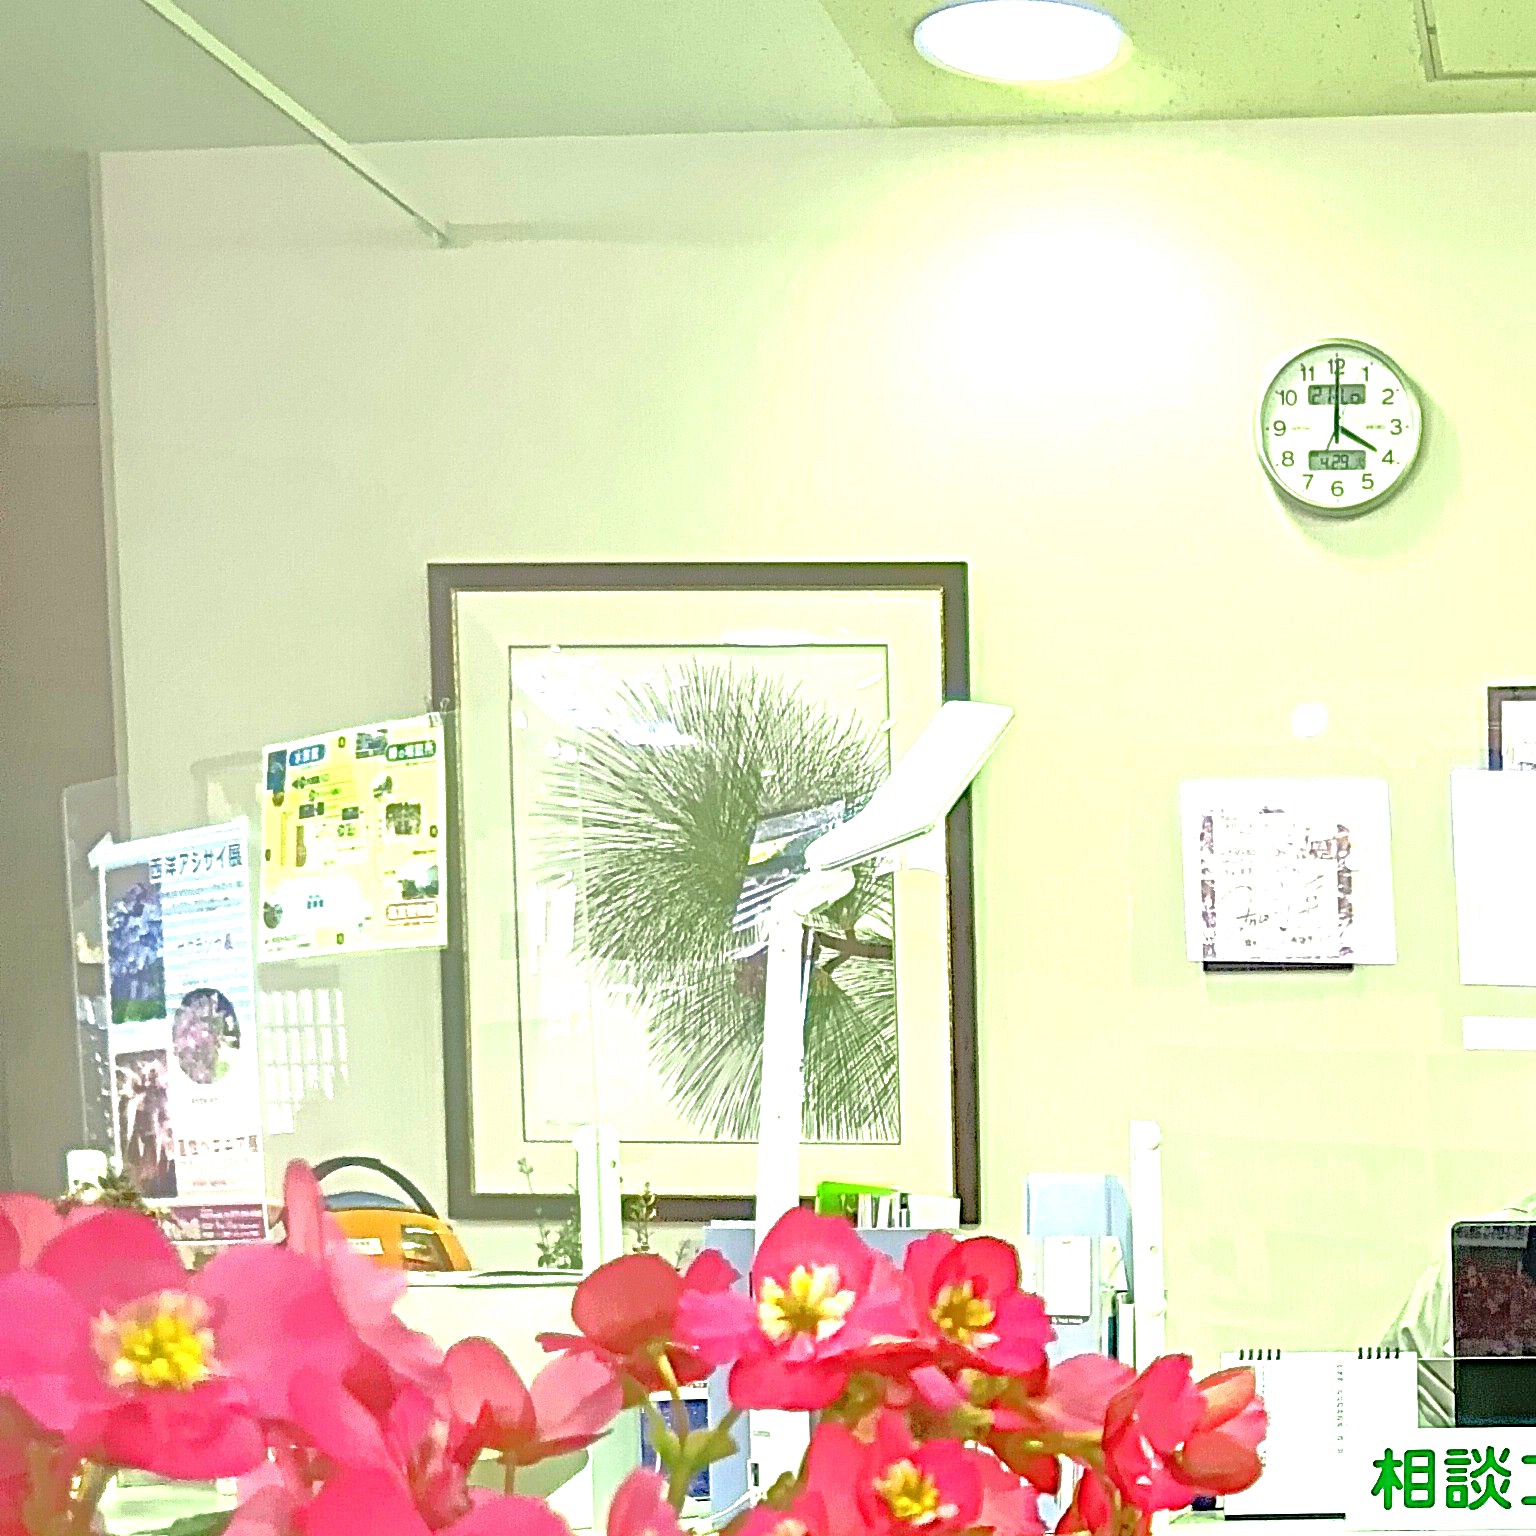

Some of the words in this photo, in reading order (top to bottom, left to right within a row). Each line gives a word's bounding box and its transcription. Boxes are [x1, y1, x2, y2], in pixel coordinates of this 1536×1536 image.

[1301, 366, 1314, 381] 11
[1328, 357, 1345, 375] 12
[1363, 366, 1369, 381] 1
[1278, 389, 1298, 406] 10
[1381, 388, 1394, 405] 2
[1273, 420, 1287, 436] 9
[1390, 418, 1403, 435] 3
[1281, 450, 1295, 467] 8
[1381, 449, 1394, 464] 4
[1302, 473, 1314, 489] 7
[1331, 480, 1344, 496] 6
[1361, 473, 1374, 489] 5
